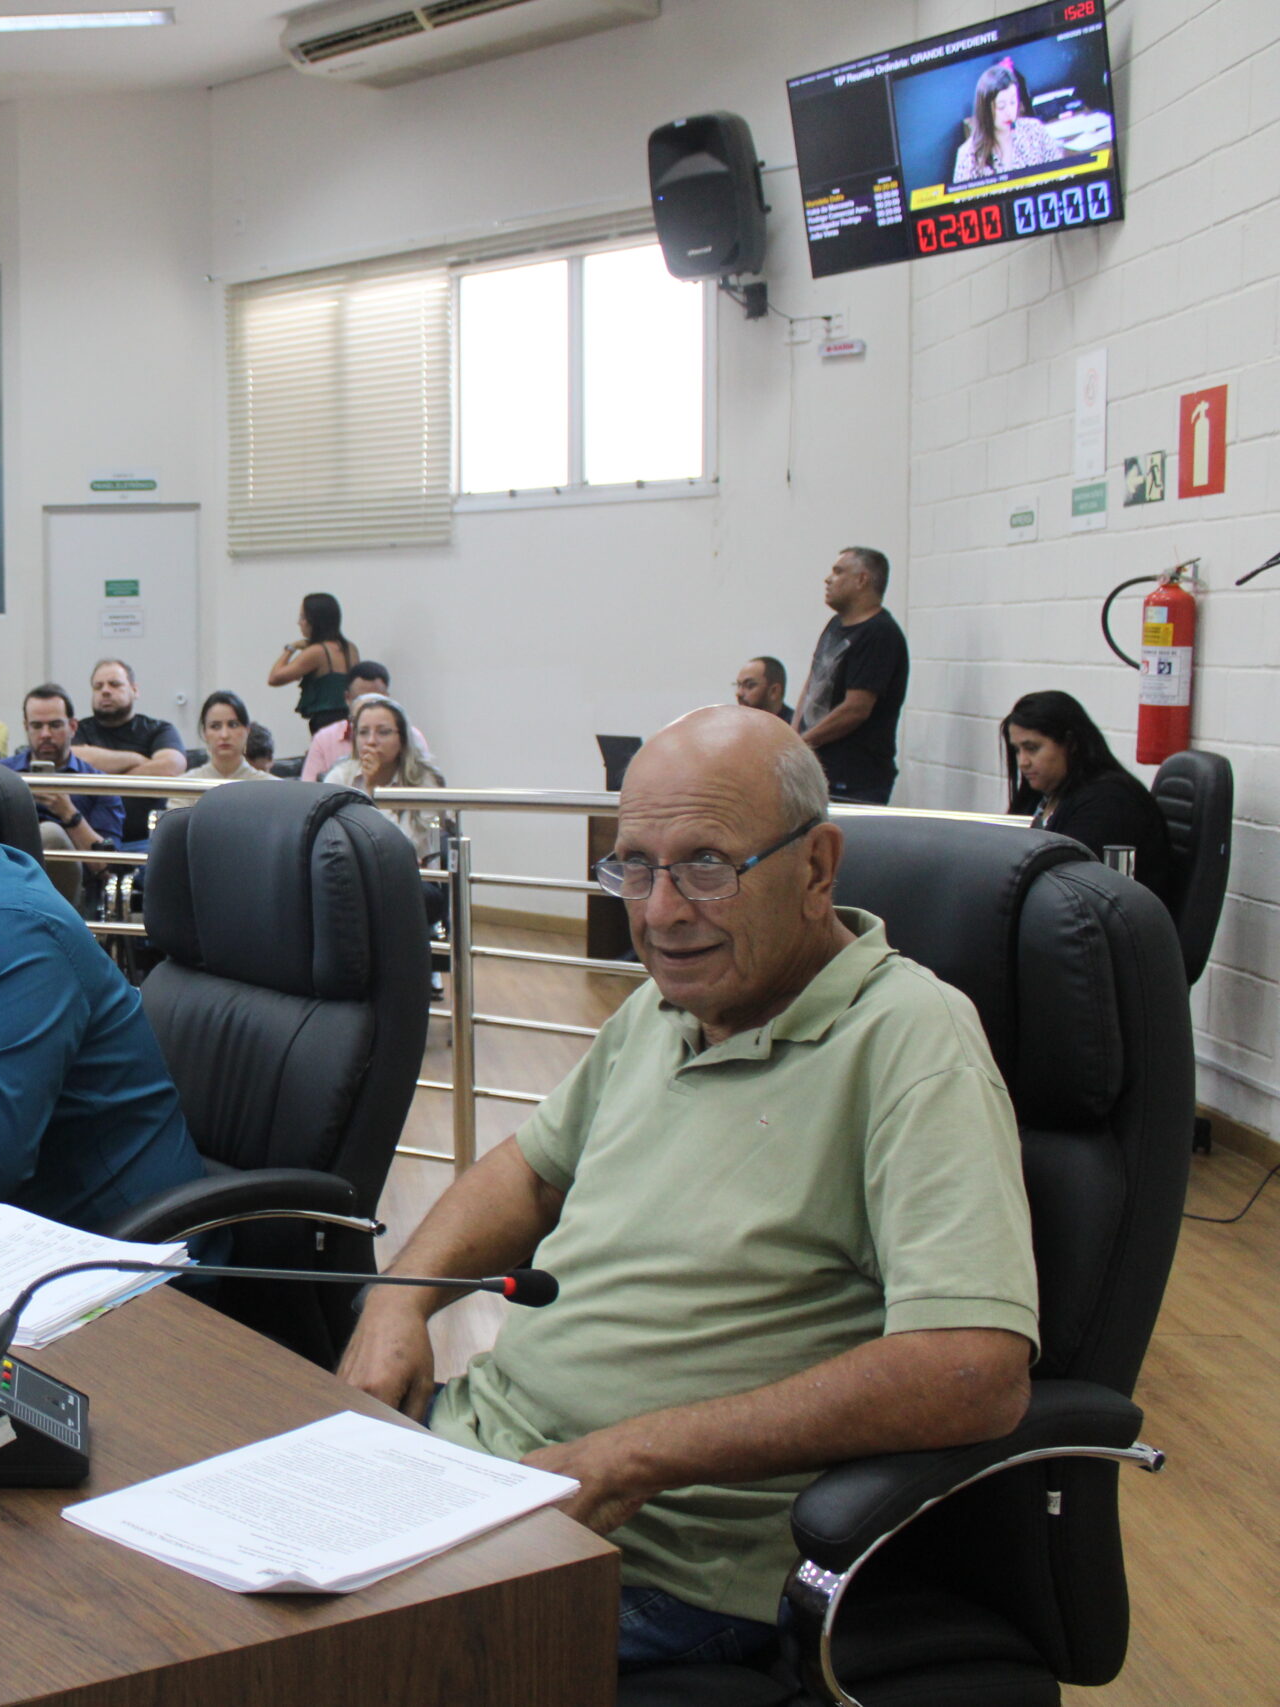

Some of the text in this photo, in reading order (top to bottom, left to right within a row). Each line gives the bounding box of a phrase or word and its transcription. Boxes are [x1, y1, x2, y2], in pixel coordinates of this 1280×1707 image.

[910, 46, 945, 65] GRANDE
[945, 30, 999, 55] EXPEDIENTE
[917, 204, 1003, 253] 02:00
[1013, 181, 1111, 235] 00:00
